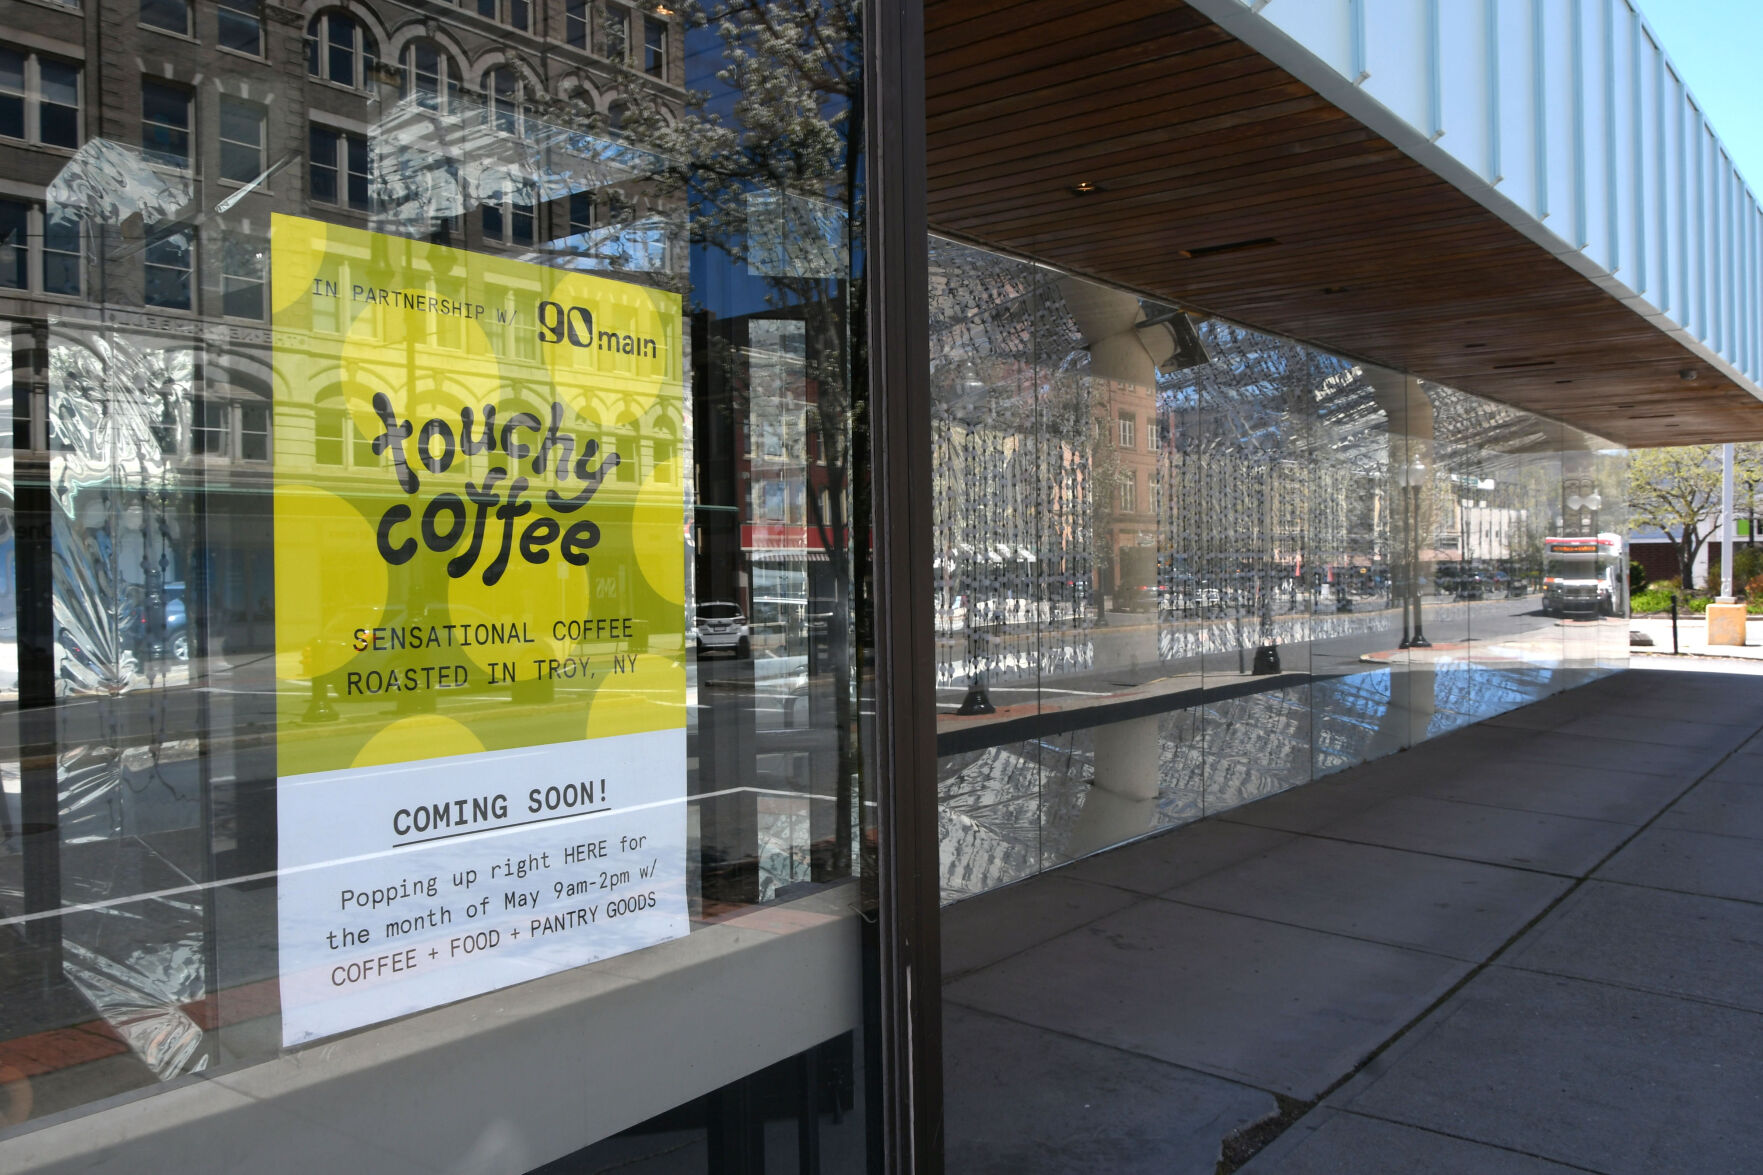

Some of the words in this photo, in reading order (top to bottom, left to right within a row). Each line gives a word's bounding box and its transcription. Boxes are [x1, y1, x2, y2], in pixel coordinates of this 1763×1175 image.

[312, 278, 337, 298] IN
[353, 284, 485, 321] PARTNERSHIP
[497, 308, 519, 326] W/
[537, 300, 594, 348] 90
[598, 329, 658, 359] main
[371, 392, 621, 514] touchy
[376, 466, 601, 587] coffee
[347, 664, 468, 696] ROASTED
[488, 660, 517, 685] IN
[533, 656, 596, 681] TROY,
[614, 654, 638, 675] NY
[353, 621, 535, 652] SENSATIONAL
[552, 617, 633, 641] COFFEE
[393, 794, 508, 836] COMING
[527, 779, 608, 813] SOON!
[326, 923, 370, 951] the
[385, 907, 453, 938] month
[466, 897, 490, 918] of
[504, 887, 541, 911] May
[553, 866, 630, 900] 9am-2pm
[639, 858, 658, 879] w/
[341, 874, 438, 911] Popping
[452, 867, 478, 890] up
[491, 850, 551, 881] right
[564, 839, 608, 865] HERE
[619, 834, 647, 853] for
[331, 947, 418, 987] COFFEE
[450, 929, 501, 958] FOOD
[530, 908, 600, 938] PANTRY
[606, 891, 657, 918] GOODS
